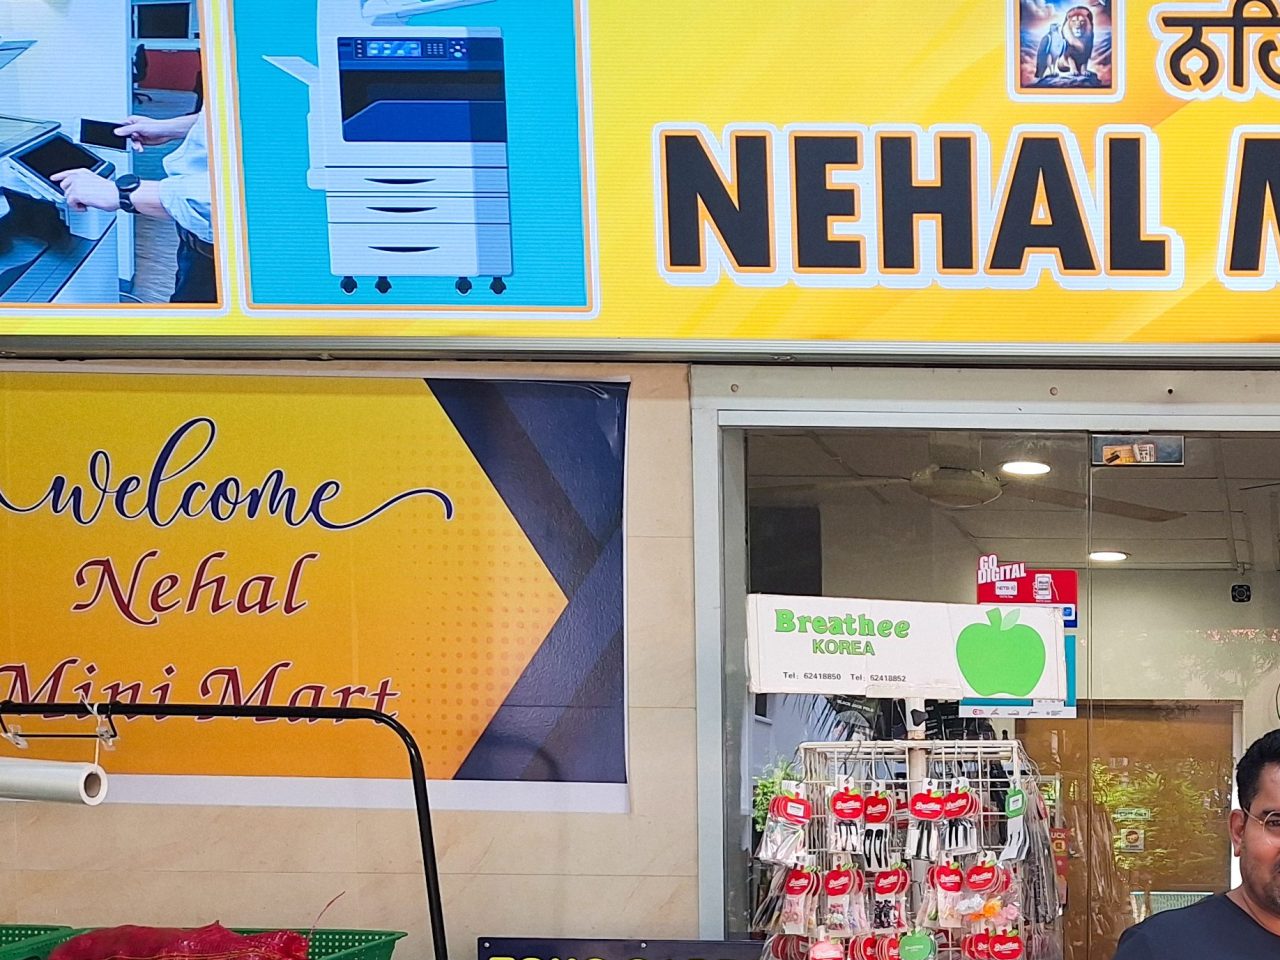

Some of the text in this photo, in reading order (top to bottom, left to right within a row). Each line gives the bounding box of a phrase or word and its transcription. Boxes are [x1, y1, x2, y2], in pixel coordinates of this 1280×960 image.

[661, 132, 1174, 274] NEHAL
[0, 416, 454, 530] welcome
[977, 562, 1027, 585] DIGITAL
[980, 554, 998, 570] GO
[71, 550, 320, 627] Nehal
[774, 608, 911, 639] Breathee
[812, 638, 876, 656] KOREA
[803, 672, 842, 680] 62418850
